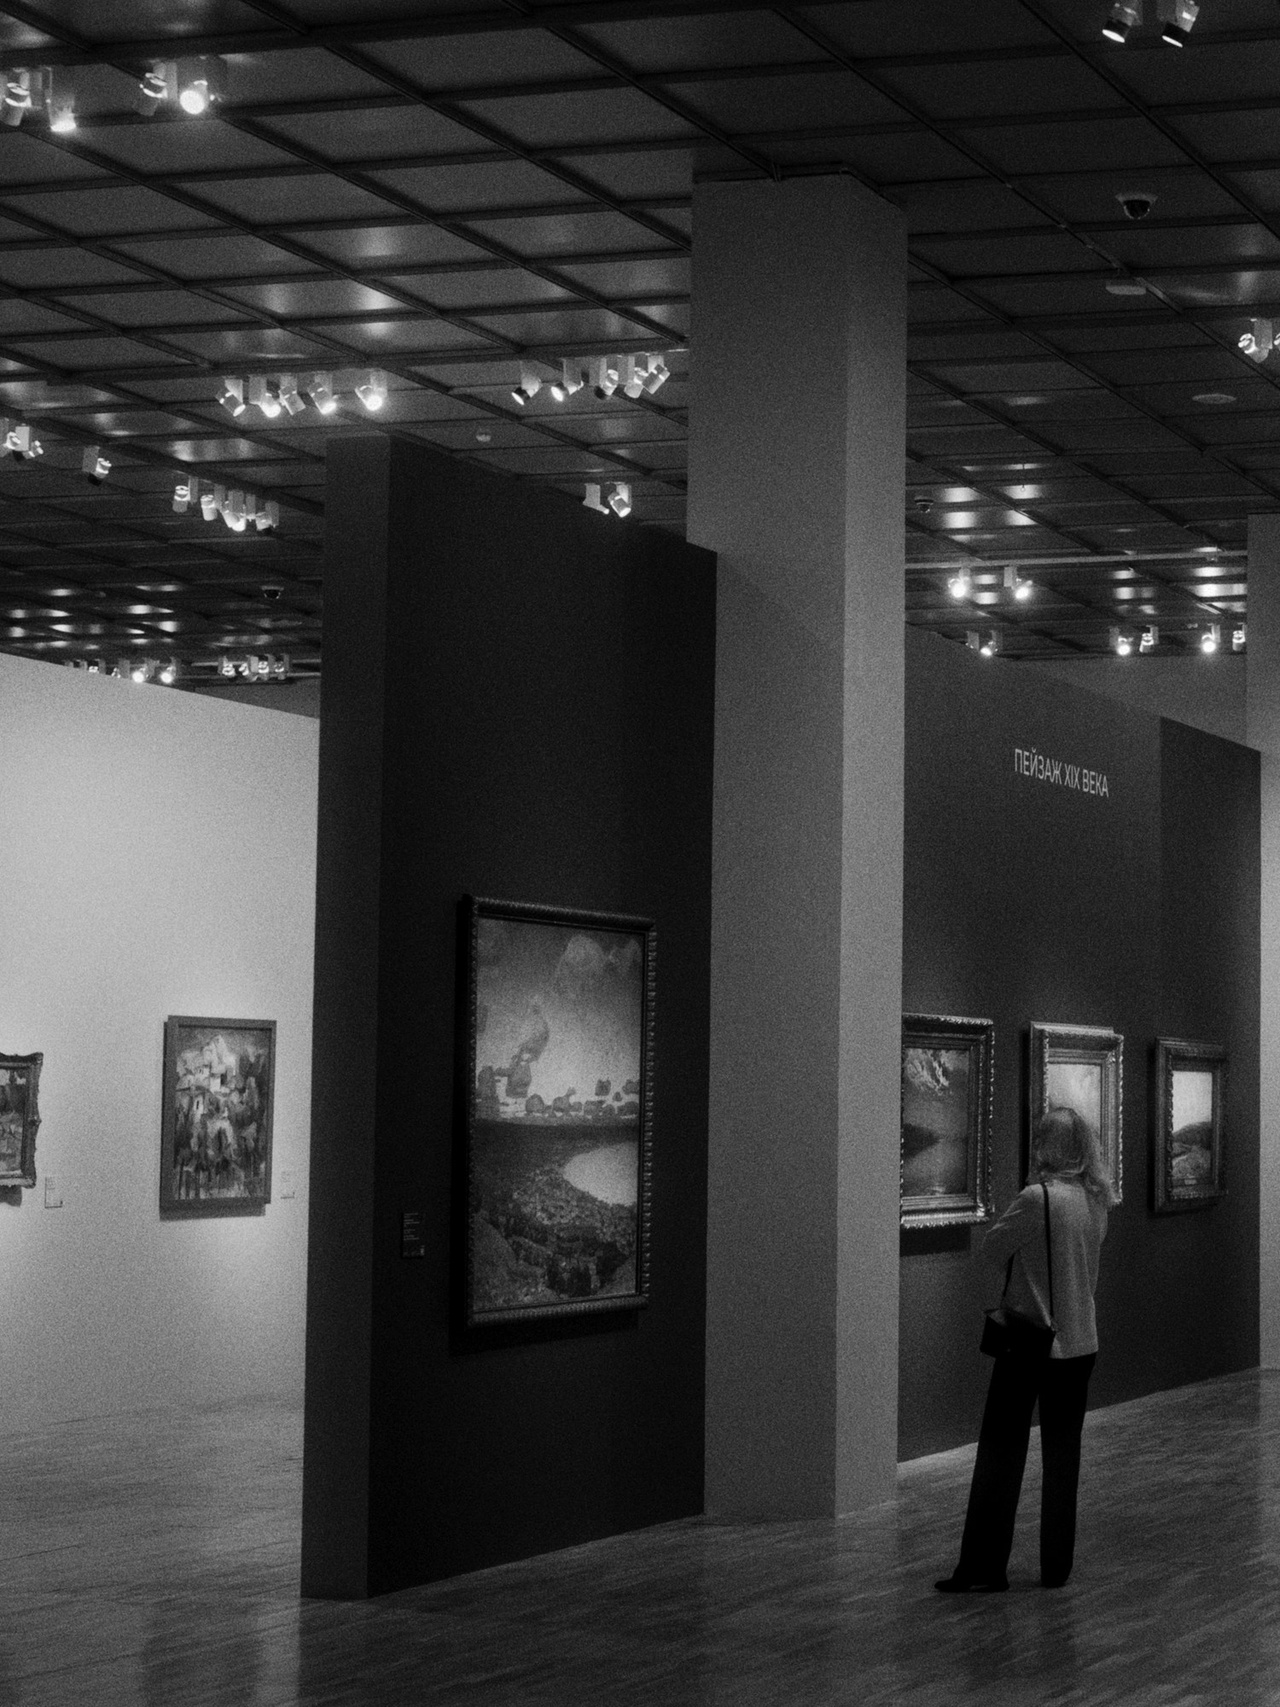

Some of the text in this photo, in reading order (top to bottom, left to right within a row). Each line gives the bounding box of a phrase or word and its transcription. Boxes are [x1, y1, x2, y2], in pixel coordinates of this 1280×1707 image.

[1014, 747, 1109, 798] ПЕЙЗАЖ XIX ВЕКА
